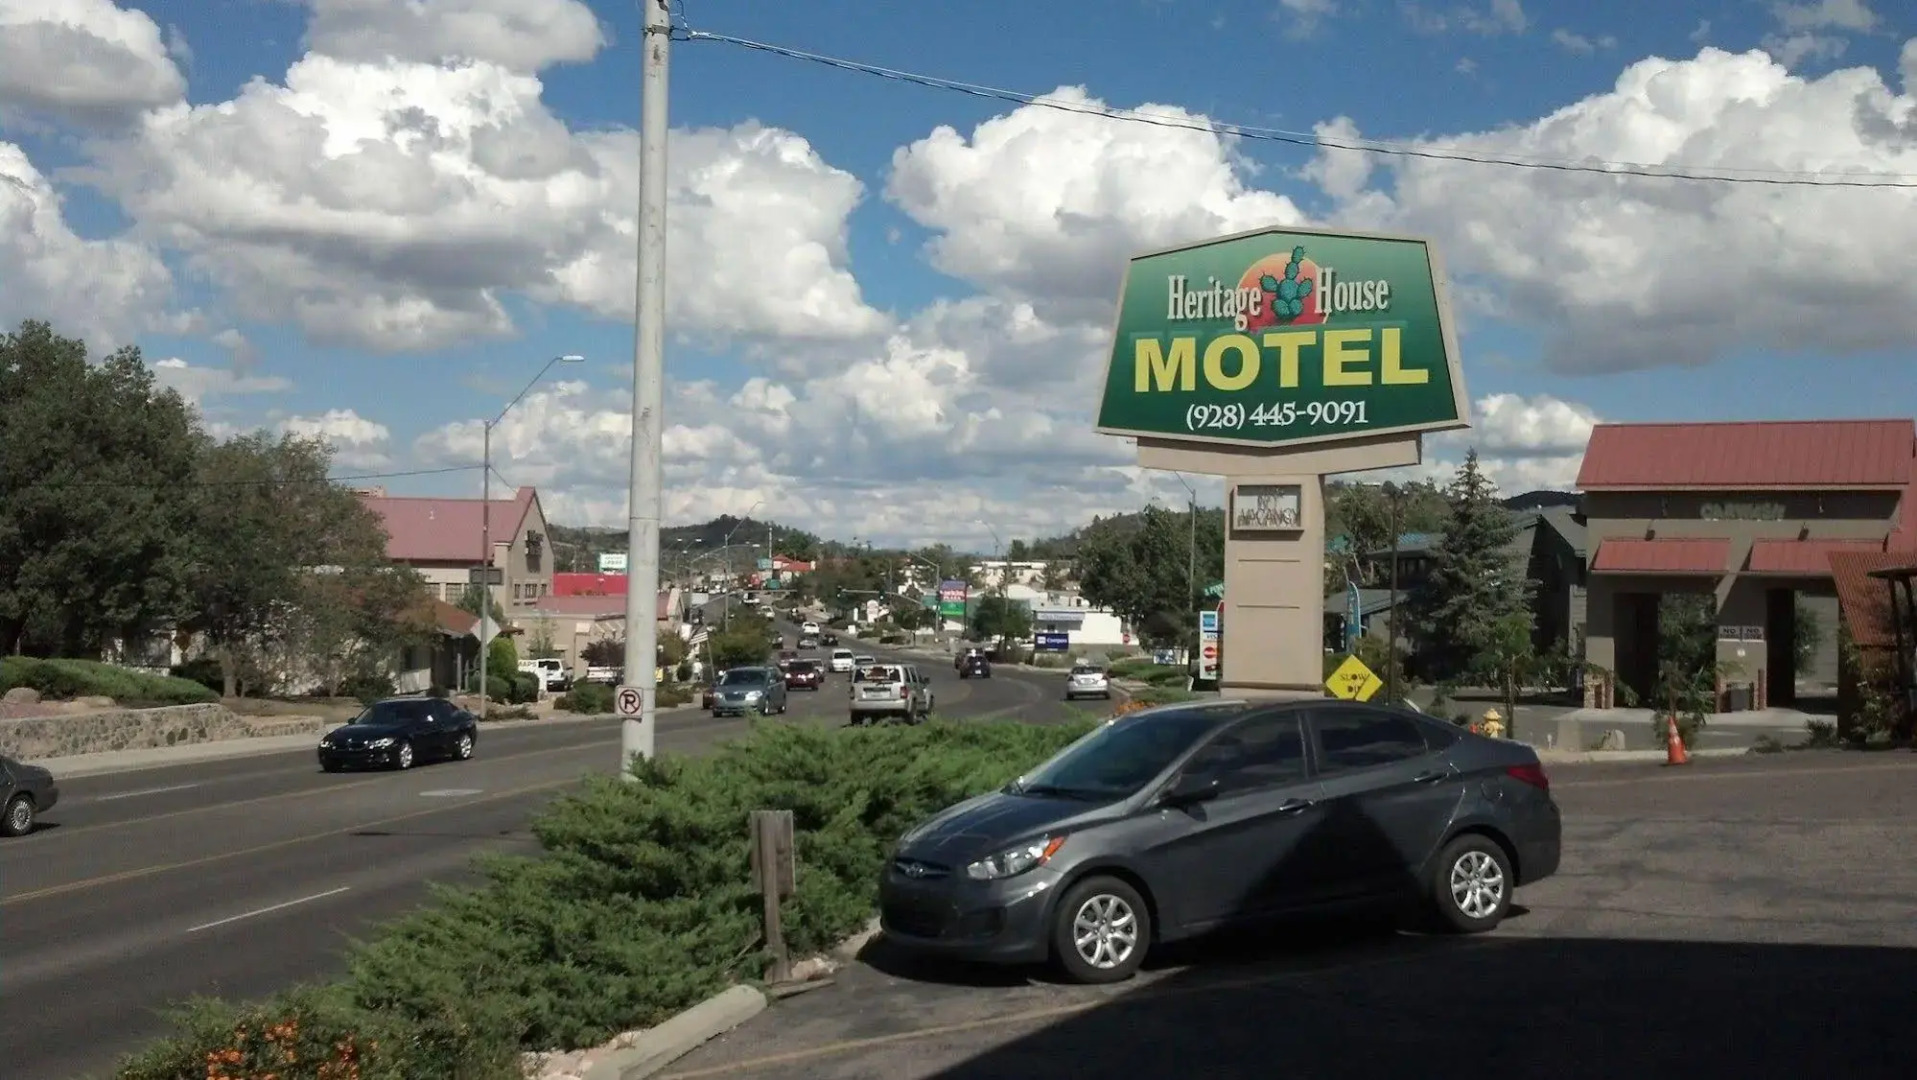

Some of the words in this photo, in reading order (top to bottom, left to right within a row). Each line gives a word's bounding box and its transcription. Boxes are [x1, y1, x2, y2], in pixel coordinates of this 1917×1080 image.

[1167, 275, 1262, 331] Heritage
[1314, 267, 1389, 324] House
[1134, 327, 1429, 393] MOTEL
[1186, 403, 1245, 429] (928)
[1249, 400, 1369, 427] 445-9091
